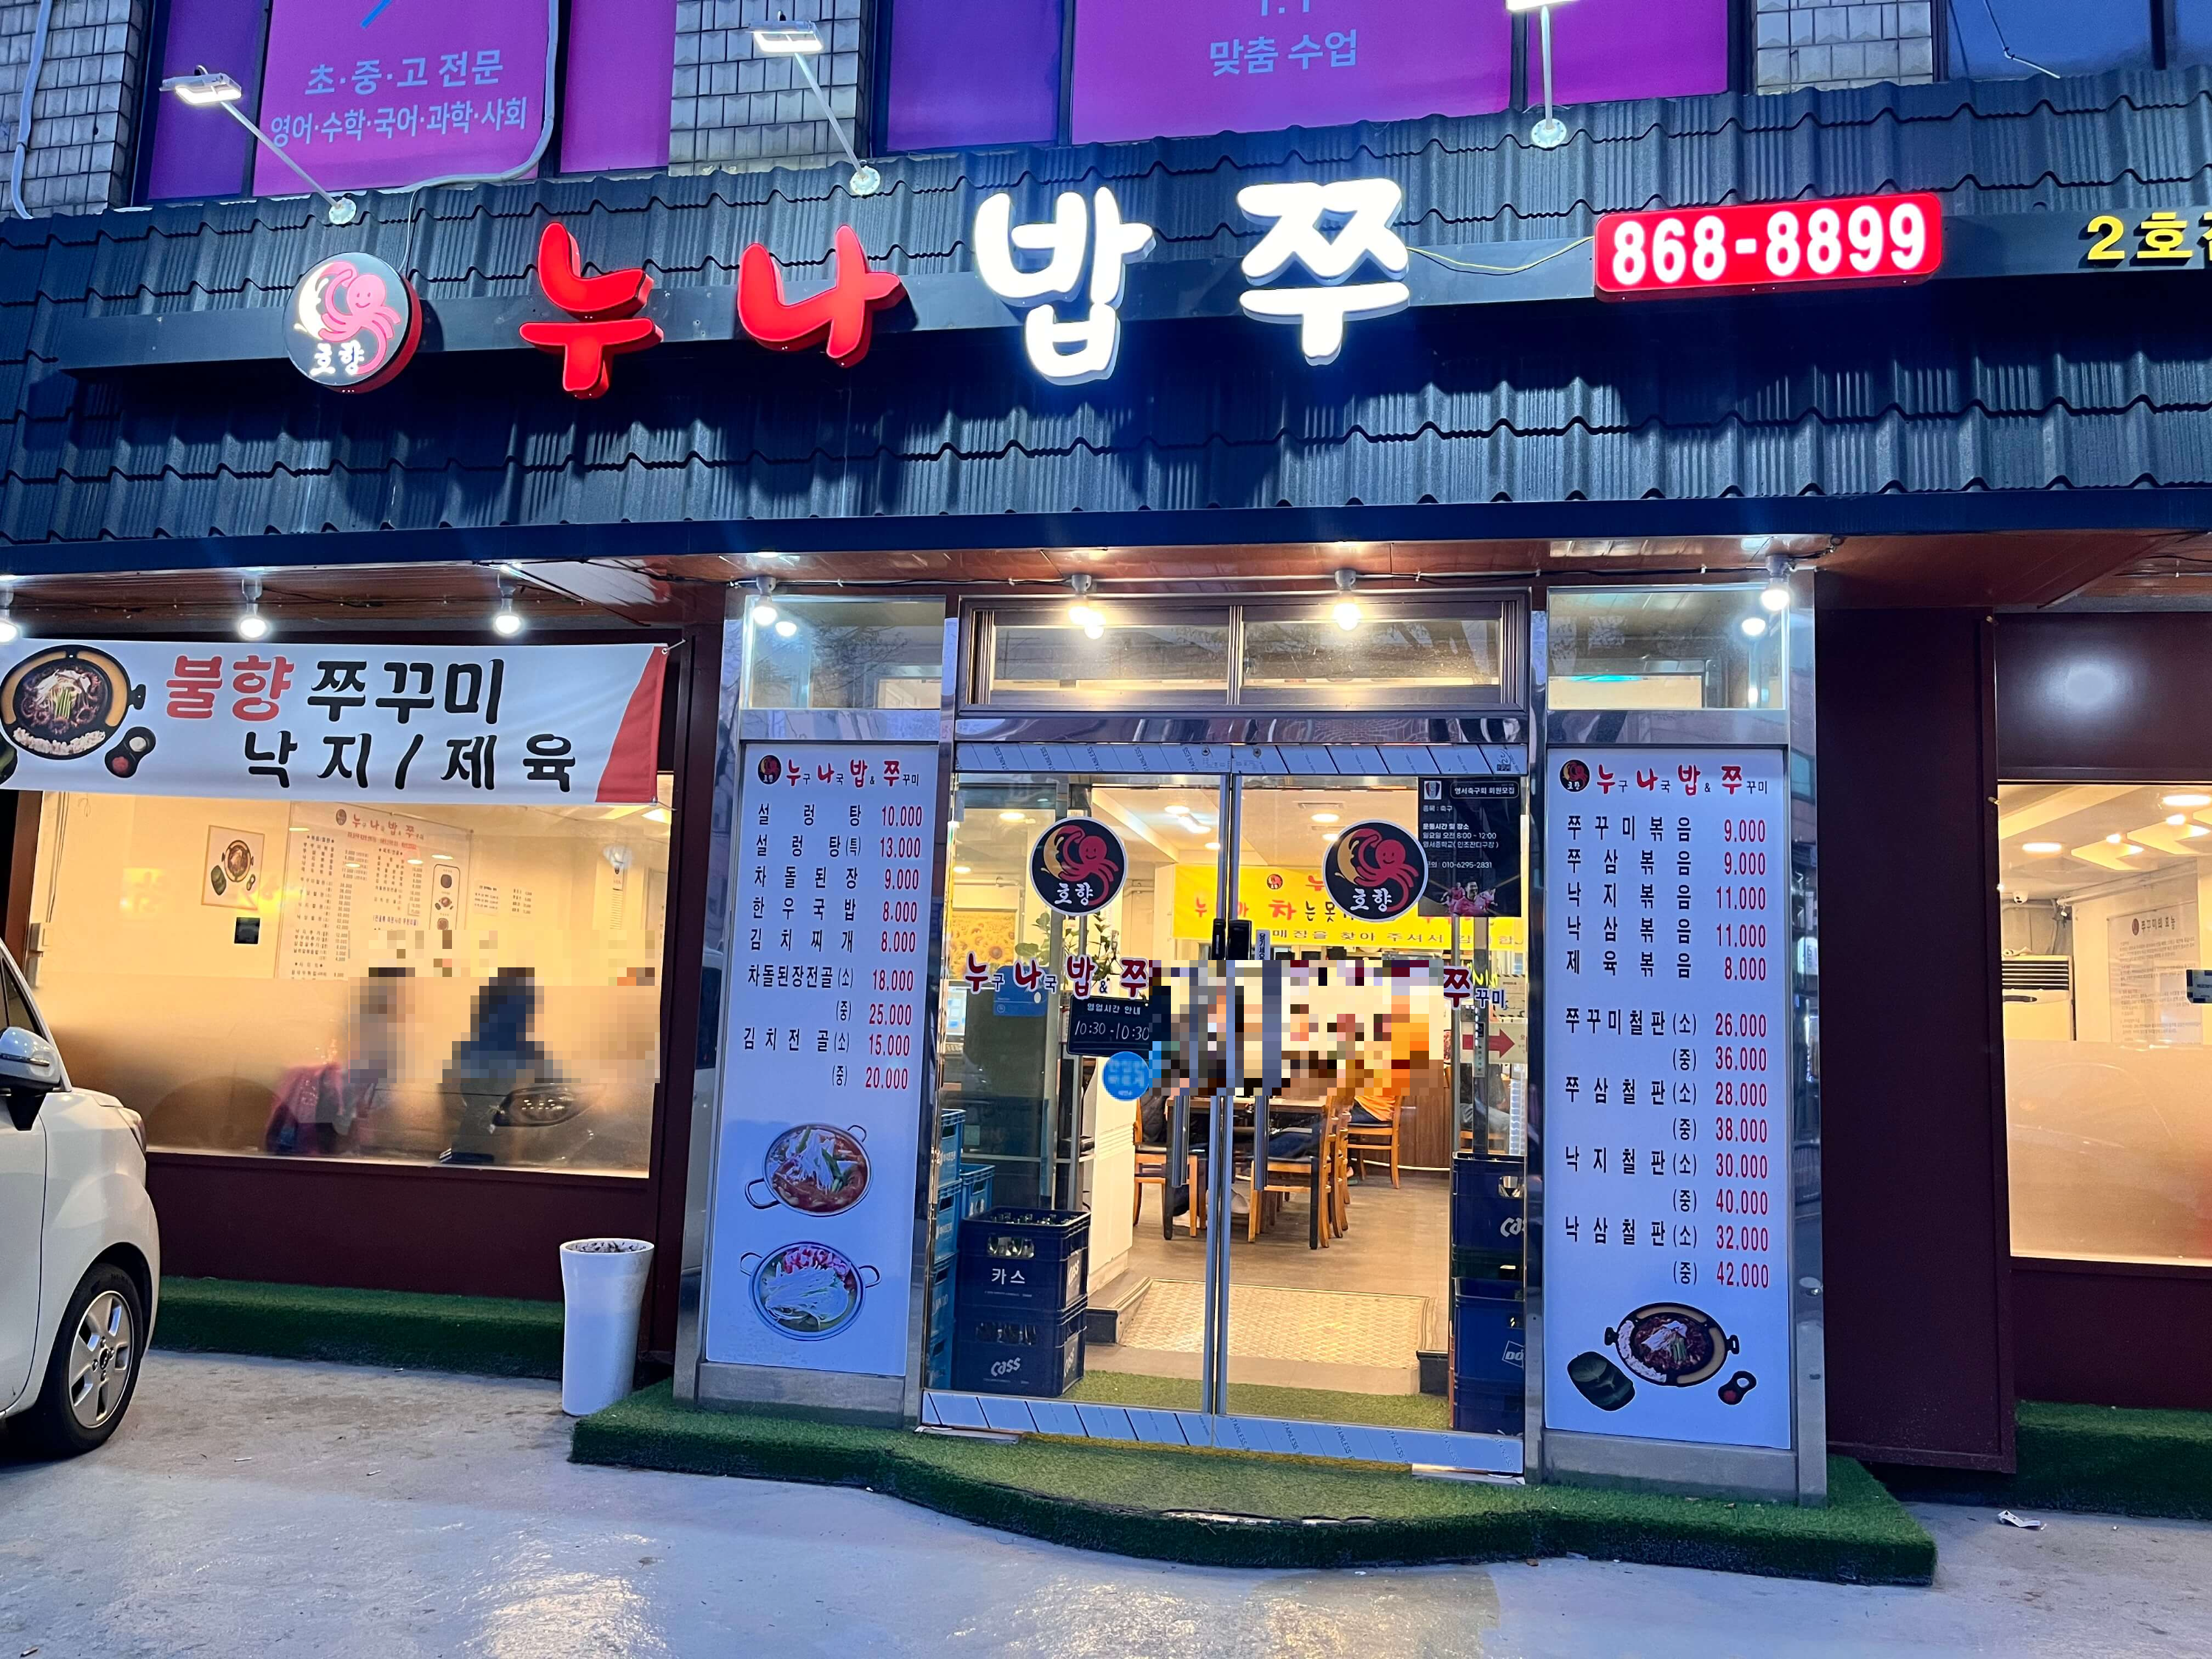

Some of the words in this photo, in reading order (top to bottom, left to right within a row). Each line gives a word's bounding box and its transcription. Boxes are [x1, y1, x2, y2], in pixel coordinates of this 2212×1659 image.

[1210, 37, 1279, 77] 맞춤
[1288, 29, 1357, 70] 수업
[438, 49, 504, 87] 전문
[1612, 203, 1926, 285] 868-8899
[2087, 212, 2212, 261] 2호
[166, 654, 295, 721] 불향
[307, 658, 504, 726] 쭈꾸미
[1489, 787, 1515, 795] 회원모집
[882, 805, 922, 827] 10.000
[1725, 819, 1766, 843] 9.000
[880, 837, 920, 858] 13.000
[1725, 852, 1766, 875] 9.000
[885, 869, 919, 890] 9.000
[1054, 882, 1093, 906] 호향
[1350, 888, 1392, 912] 호향
[1717, 886, 1766, 910] 11.000
[883, 901, 917, 922] 8.000
[881, 931, 916, 953] 8.000
[1717, 923, 1766, 947] 11.000
[872, 969, 914, 991] 18.000
[1725, 956, 1766, 981] 8.000
[869, 1004, 911, 1026] 25.000
[1088, 1003, 1120, 1013] 영업시간
[1124, 1006, 1141, 1015] 안내
[1715, 1012, 1767, 1037] 26.000
[869, 1034, 910, 1056] 15.000
[1715, 1046, 1767, 1071] 36.000
[865, 1067, 908, 1089] 20.000
[1715, 1081, 1767, 1107] 28.000
[1715, 1116, 1767, 1143] 38.000
[1715, 1152, 1768, 1179] 30.000
[1715, 1189, 1768, 1215] 40.000
[1716, 1224, 1768, 1252] 32.000
[992, 1268, 1026, 1284] 카스
[1717, 1262, 1769, 1289] 42.000
[1230, 1417, 1248, 1448] STAINLESS
[1281, 1422, 1298, 1450] STAINLESS
[1334, 1425, 1352, 1454] STAINLESS
[1386, 1430, 1405, 1458] STAINLESS
[1440, 1434, 1458, 1463] STAINLESS
[1495, 1438, 1513, 1468] STAINLESS
